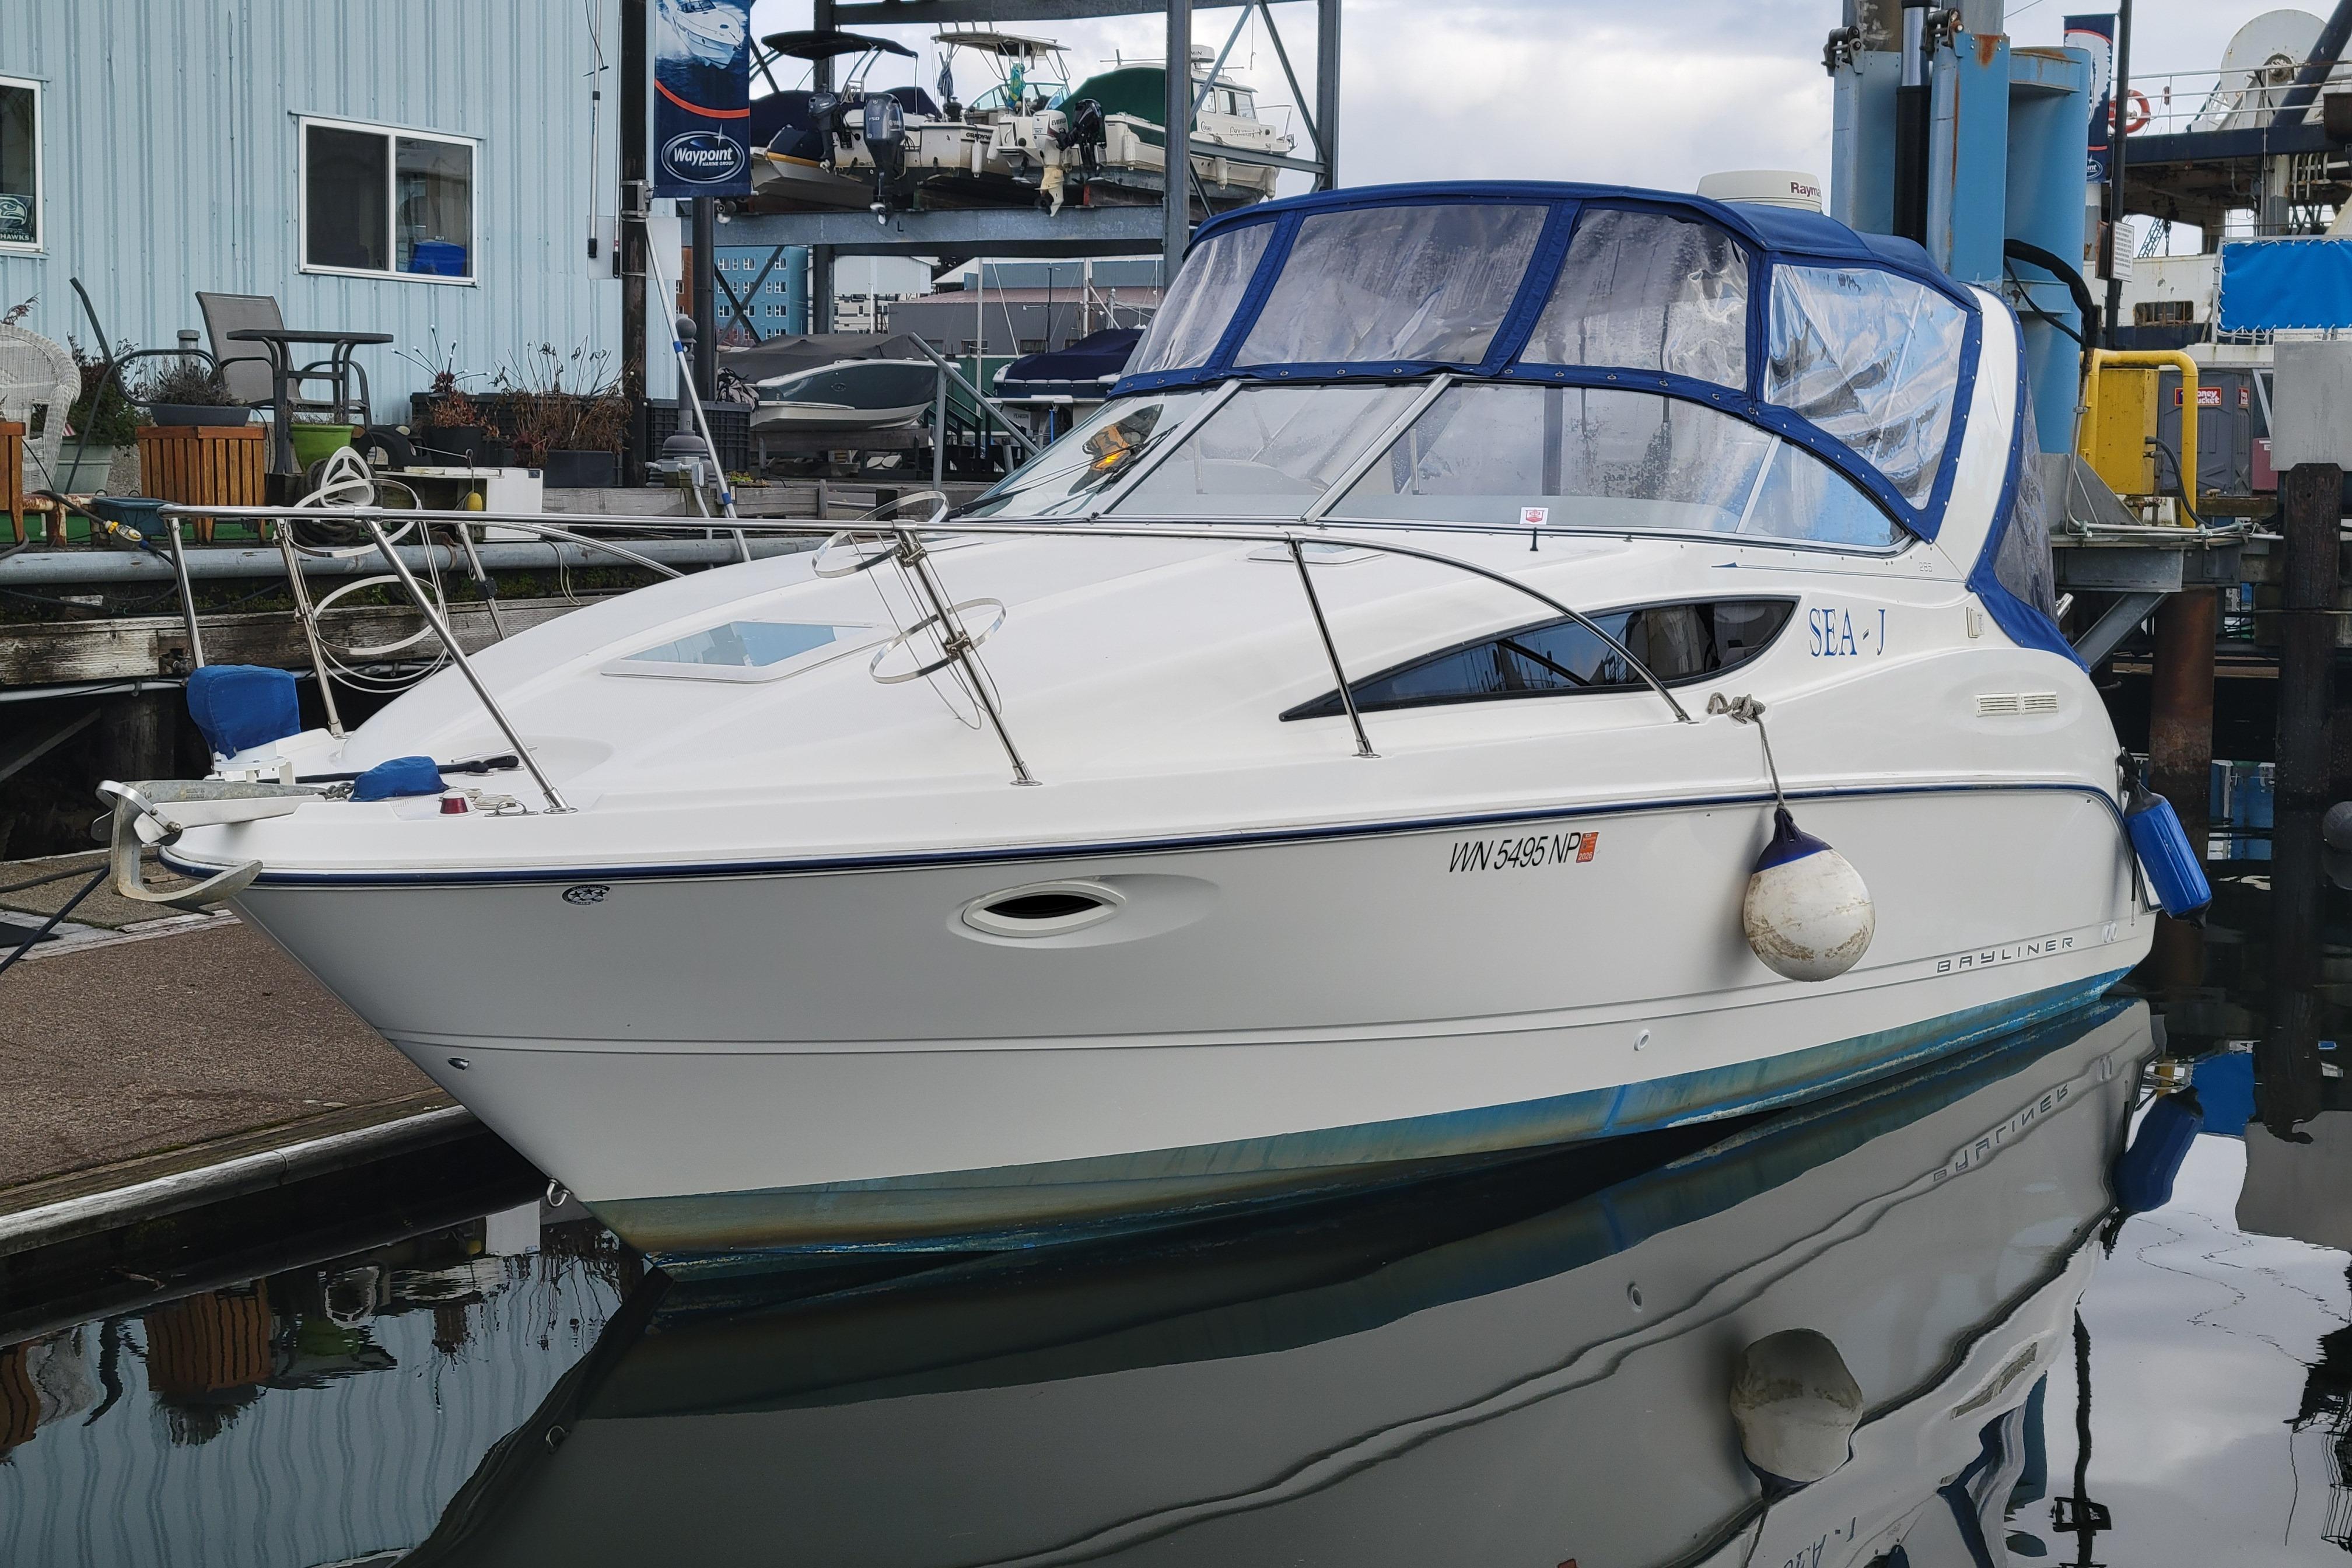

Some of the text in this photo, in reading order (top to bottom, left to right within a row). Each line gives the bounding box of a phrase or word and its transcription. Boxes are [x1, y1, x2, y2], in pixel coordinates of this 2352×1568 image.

[674, 147, 733, 166] Waypoint
[897, 220, 904, 232] L
[1809, 607, 1858, 657] SEA
[1877, 608, 1886, 656] J
[1449, 832, 1581, 873] WN 5495 NP
[1578, 852, 1593, 860] 2026
[1937, 936, 2073, 974] BAYLINER
